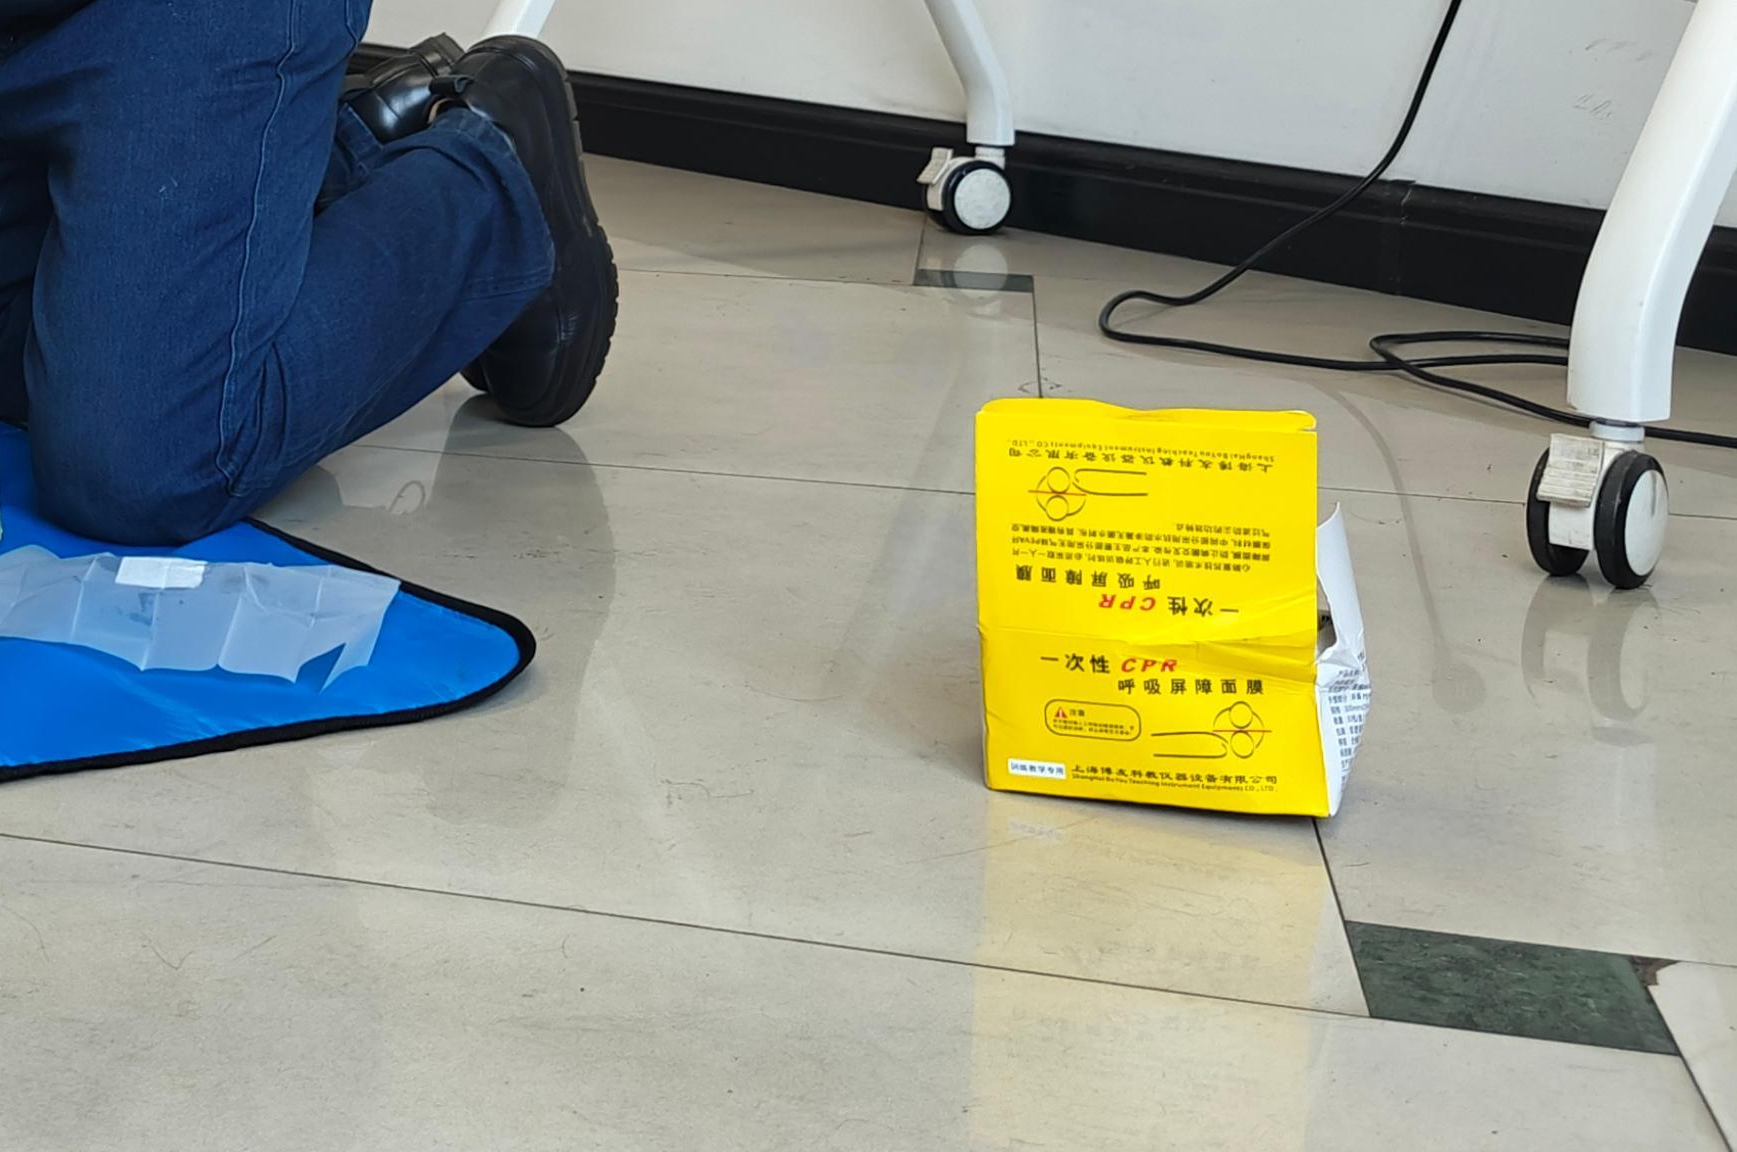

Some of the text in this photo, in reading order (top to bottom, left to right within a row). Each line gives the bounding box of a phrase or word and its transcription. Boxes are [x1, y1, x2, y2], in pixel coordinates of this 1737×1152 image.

[1015, 564, 1161, 591] 呼吸屏障面膜
[1098, 593, 1240, 617] 一次性 CPR
[1040, 653, 1179, 674] 一次性 CPR
[1117, 678, 1265, 695] 呼吸屏障面膜
